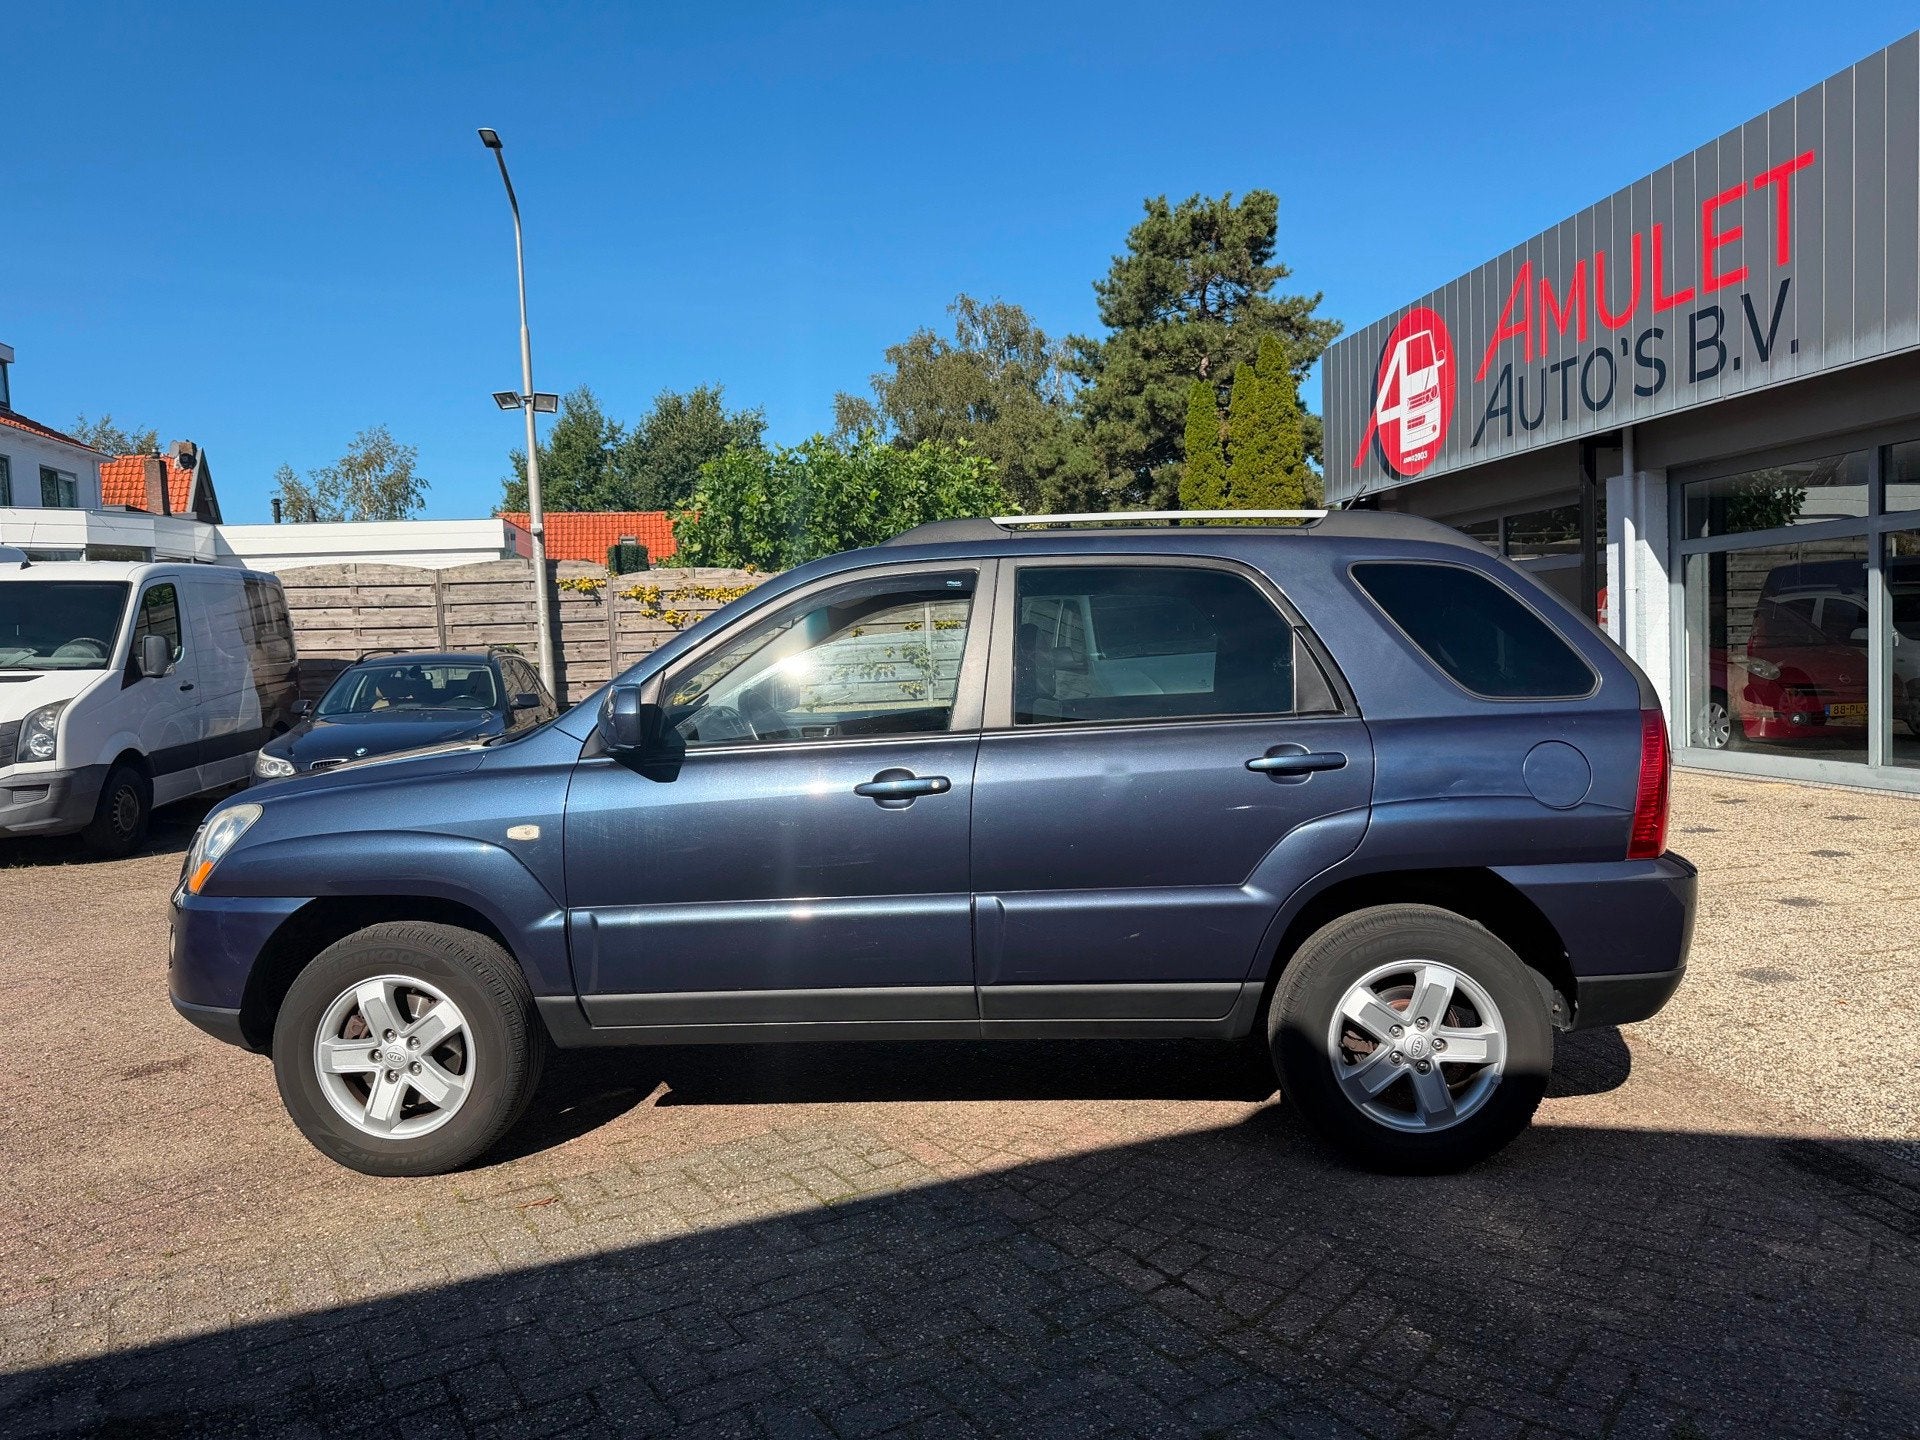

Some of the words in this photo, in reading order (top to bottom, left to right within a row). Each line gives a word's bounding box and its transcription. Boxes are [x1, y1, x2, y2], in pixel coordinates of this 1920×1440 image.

[1470, 327, 1667, 448] AUTO'S
[1688, 277, 1799, 385] B.V.
[1474, 149, 1816, 383] AMULET
